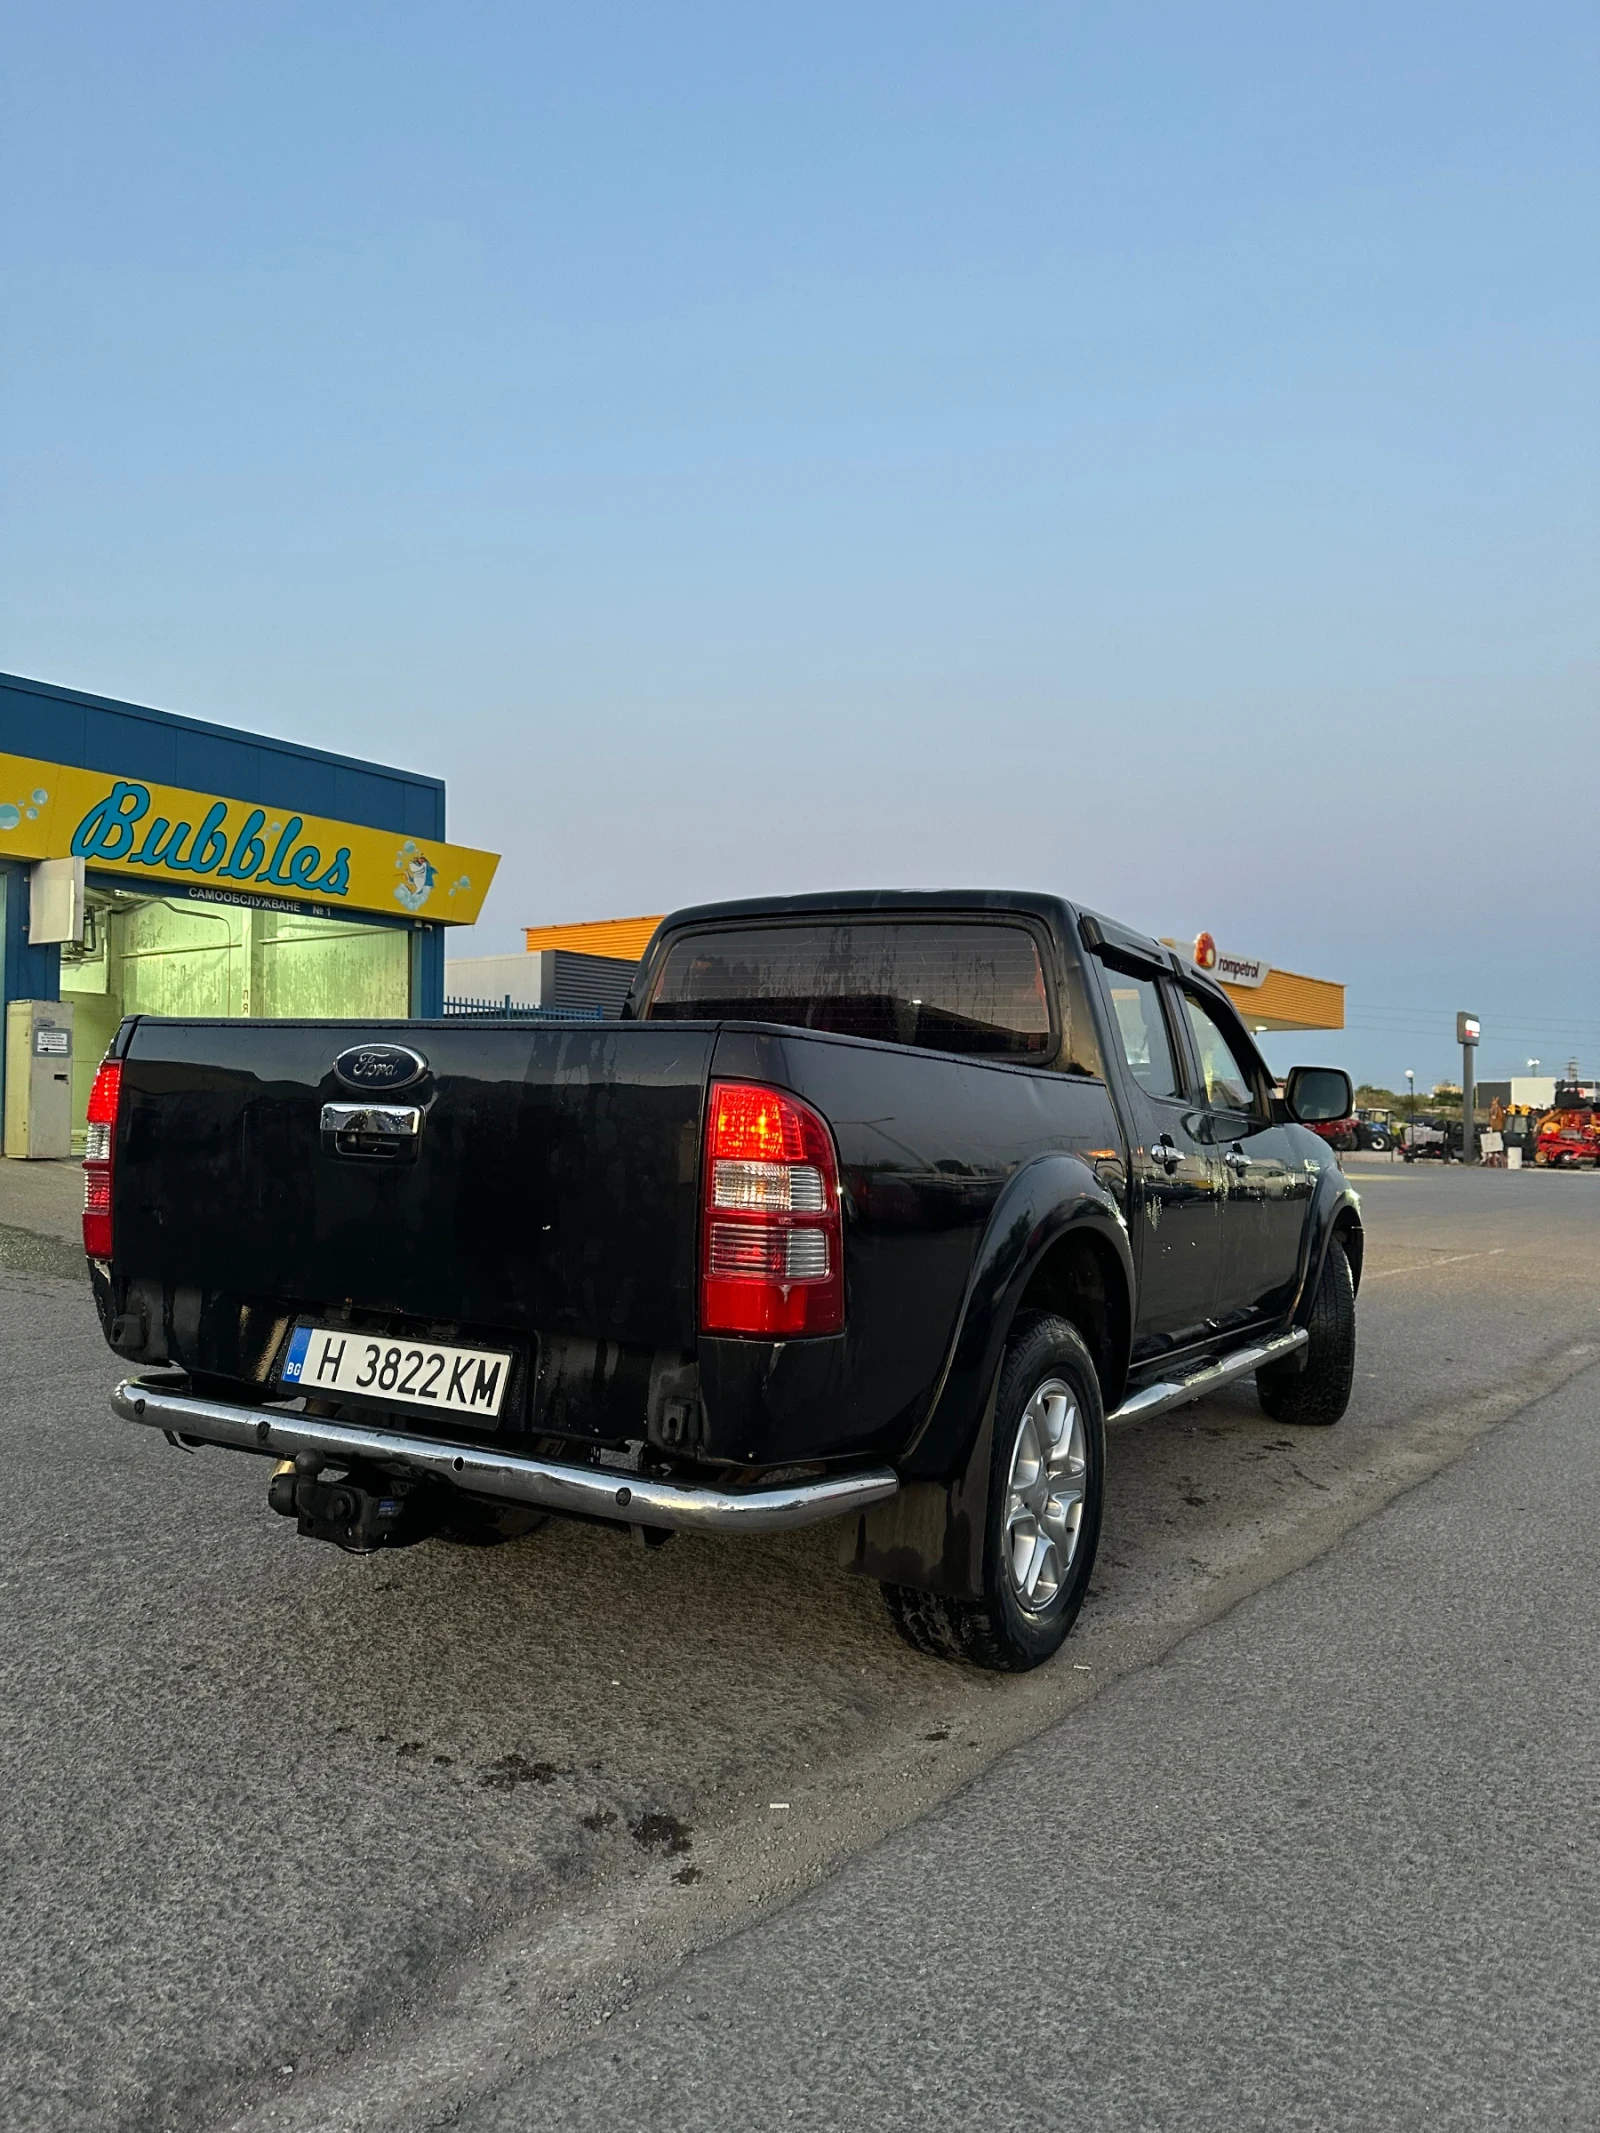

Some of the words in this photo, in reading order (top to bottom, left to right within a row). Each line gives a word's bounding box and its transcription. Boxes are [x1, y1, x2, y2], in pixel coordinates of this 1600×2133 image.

[70, 781, 351, 895] Bubbles
[188, 887, 301, 912] САМООБСЛУЖВАНЕ
[1218, 957, 1260, 980] rompetrol
[353, 1051, 400, 1077] Ford
[286, 1362, 302, 1376] BG
[316, 1337, 347, 1383] H
